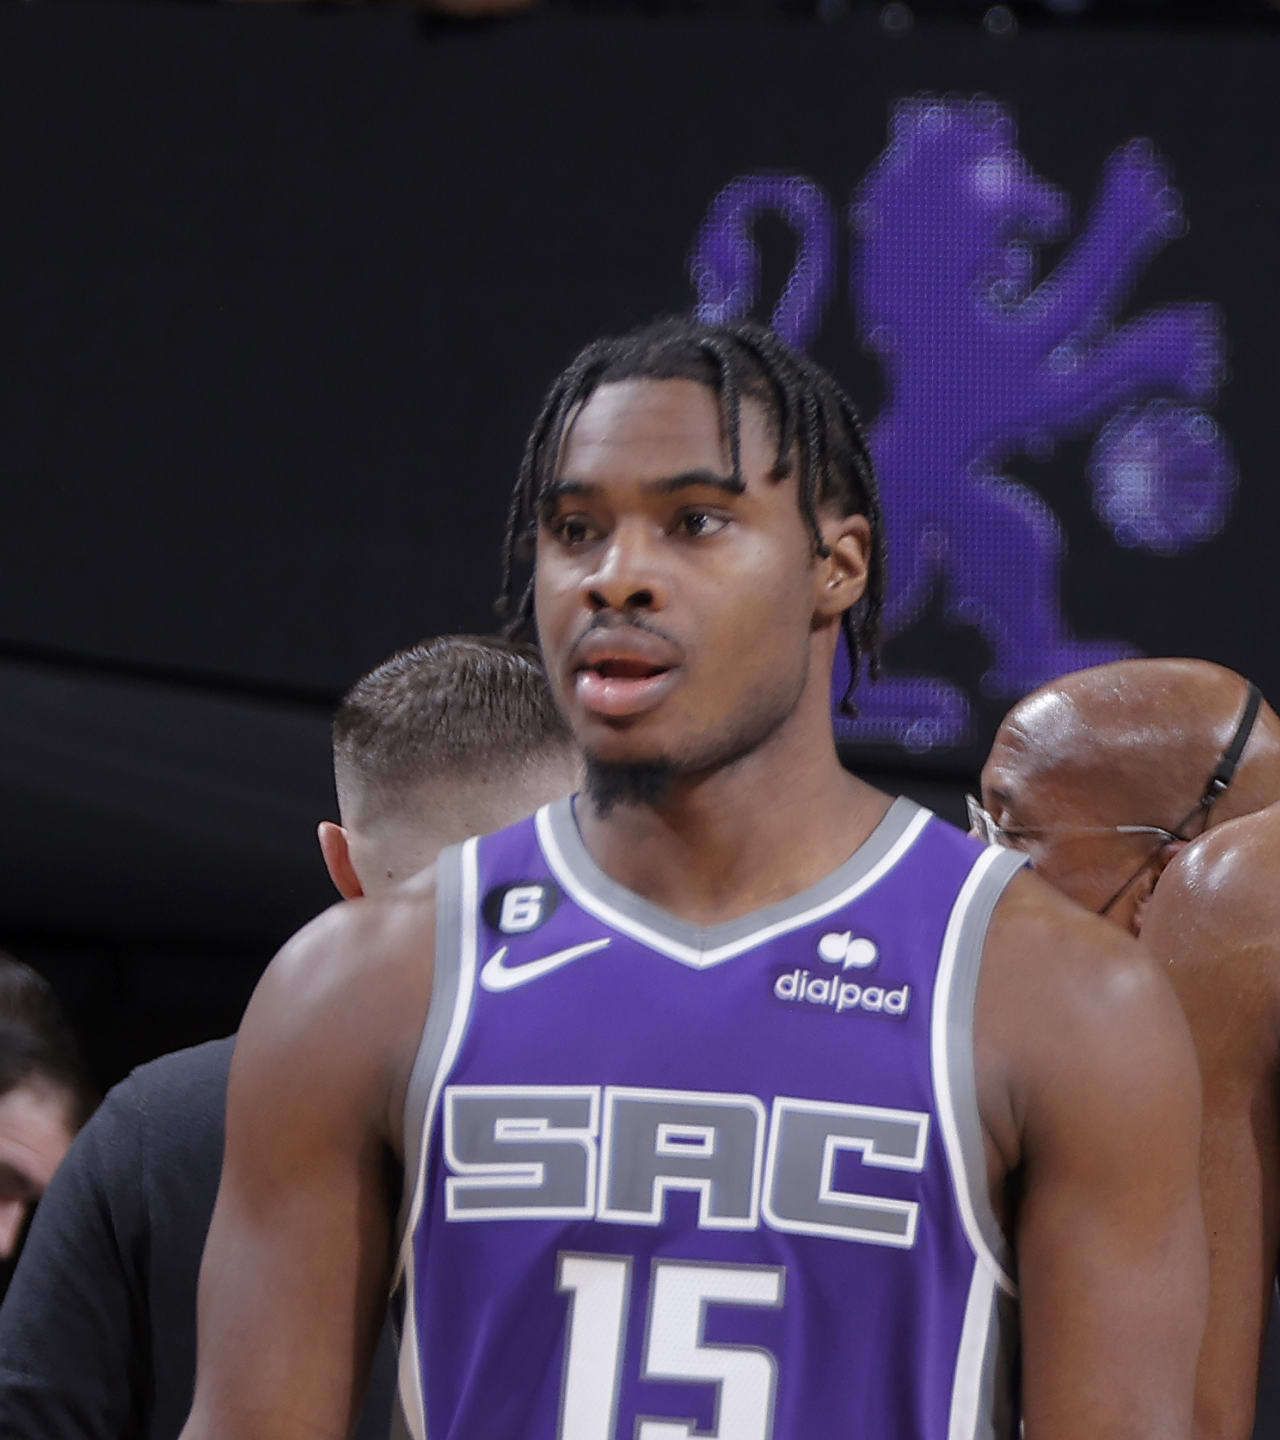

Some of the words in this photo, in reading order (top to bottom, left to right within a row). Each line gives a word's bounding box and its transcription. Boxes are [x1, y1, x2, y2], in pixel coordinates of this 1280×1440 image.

[499, 886, 543, 933] 6
[774, 968, 909, 1015] dialpad
[443, 1085, 930, 1249] SAC
